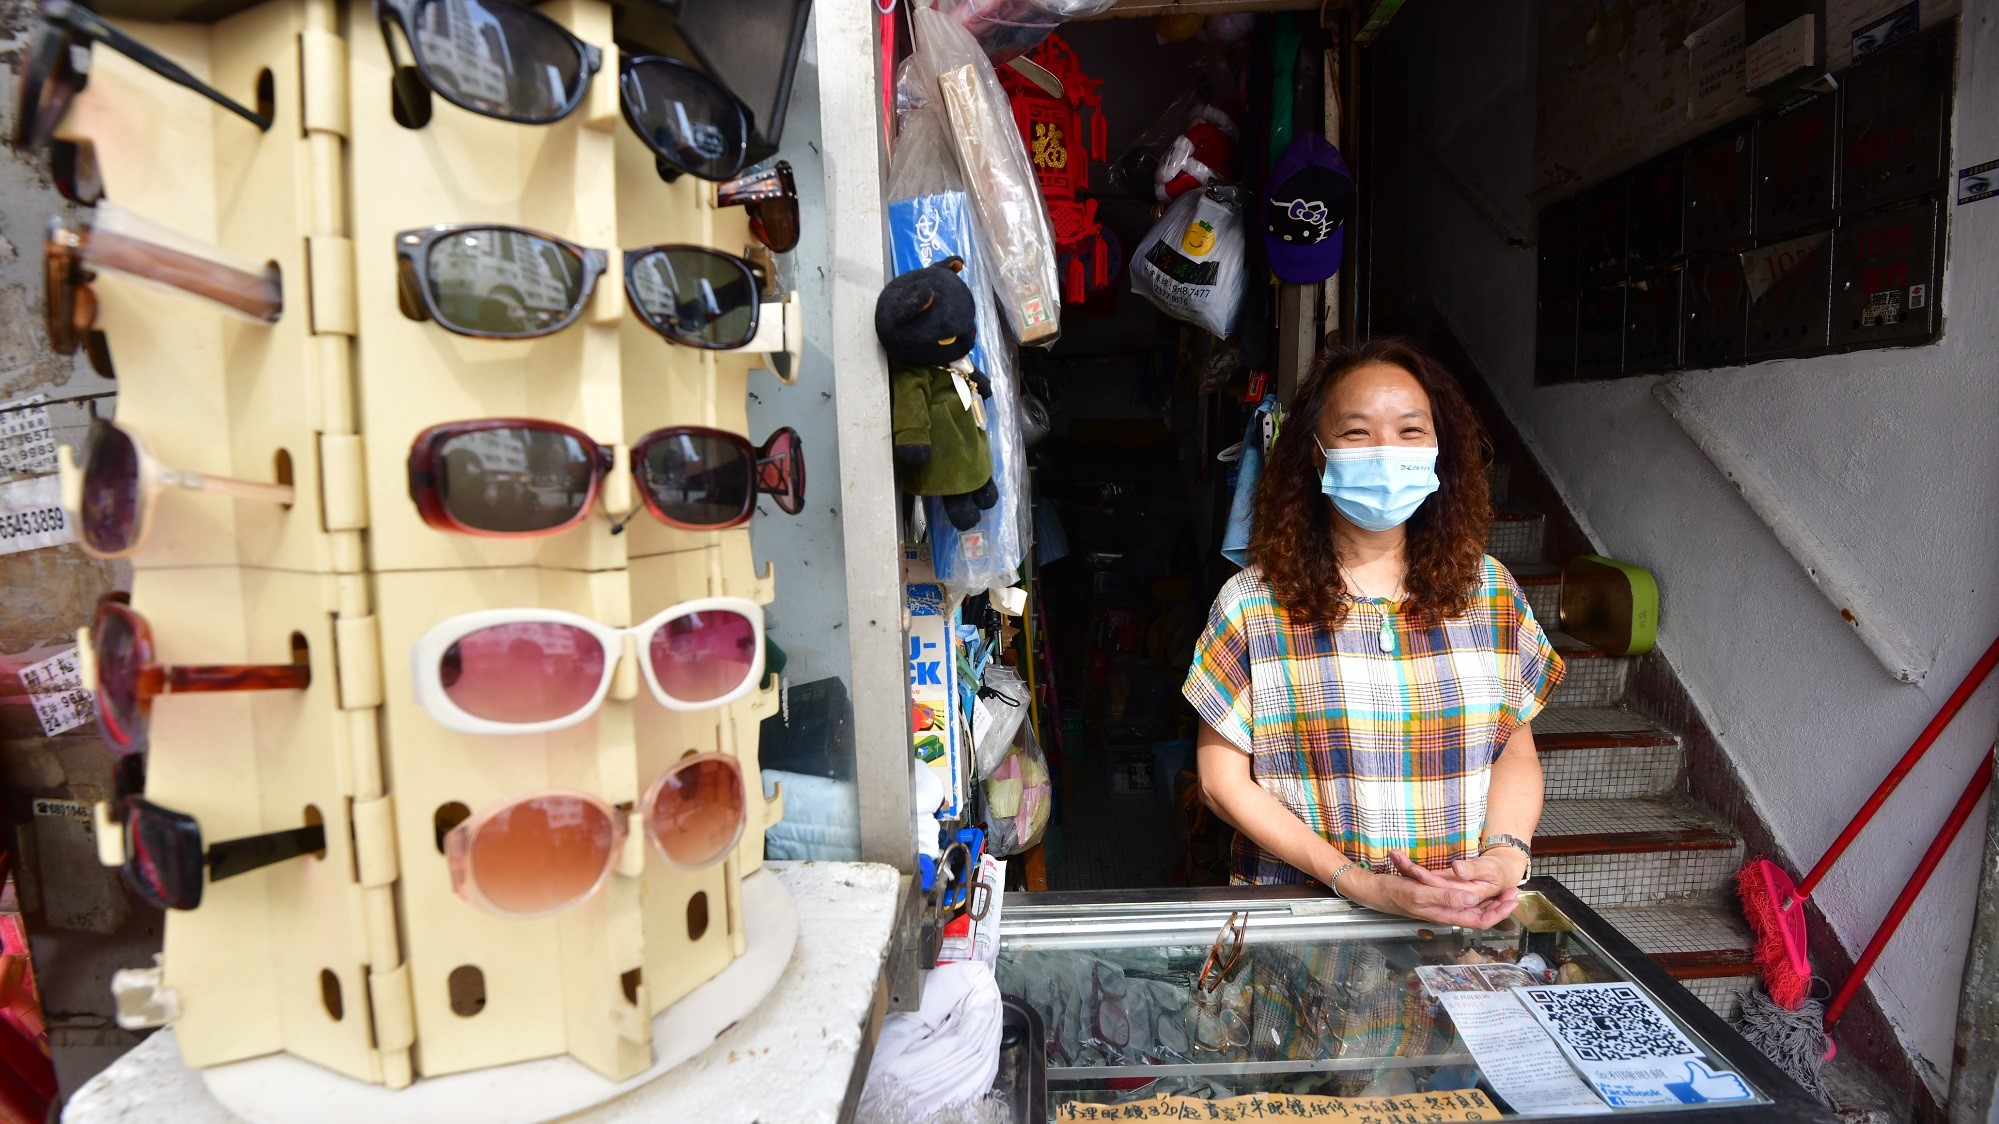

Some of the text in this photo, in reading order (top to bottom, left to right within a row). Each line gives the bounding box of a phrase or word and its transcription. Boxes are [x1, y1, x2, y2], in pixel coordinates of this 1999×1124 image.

[1031, 123, 1068, 169] 福
[1153, 284, 1171, 299] 2377
[1188, 288, 1211, 298] 7477
[1600, 1086, 1663, 1097] facebook
